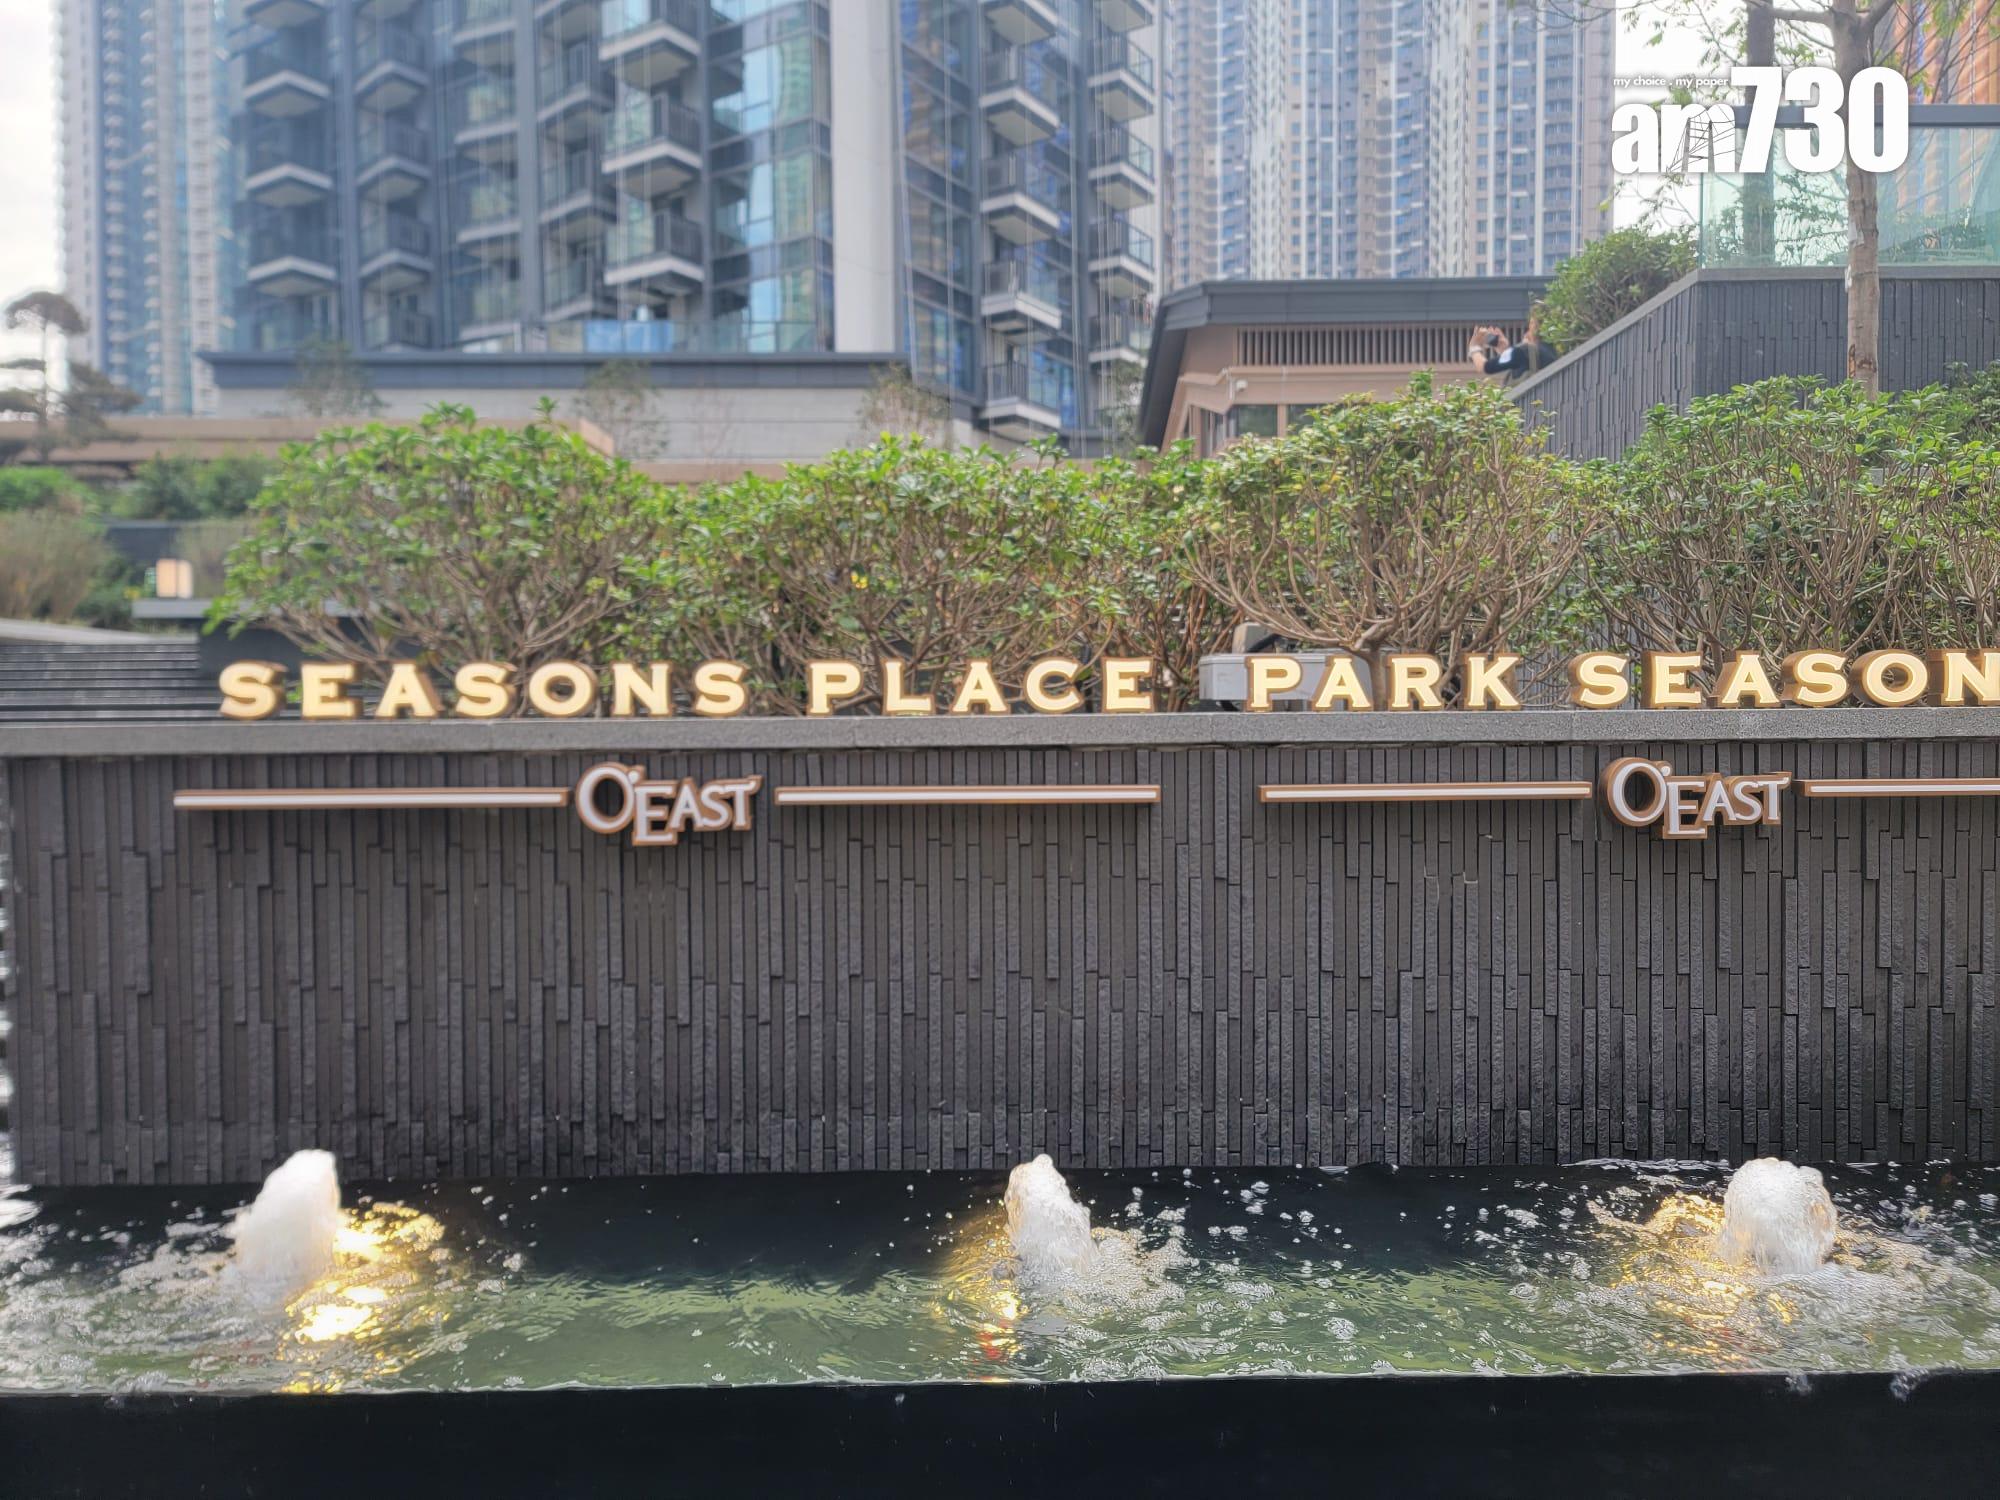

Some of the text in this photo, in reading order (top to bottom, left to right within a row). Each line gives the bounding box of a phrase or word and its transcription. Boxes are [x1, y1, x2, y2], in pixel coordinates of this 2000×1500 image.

[217, 656, 1157, 721] SEASONS PLACE
[1244, 649, 2000, 713] PARK SEASON
[575, 761, 764, 846] O'EAST
[1606, 756, 1792, 839] O'EAST
